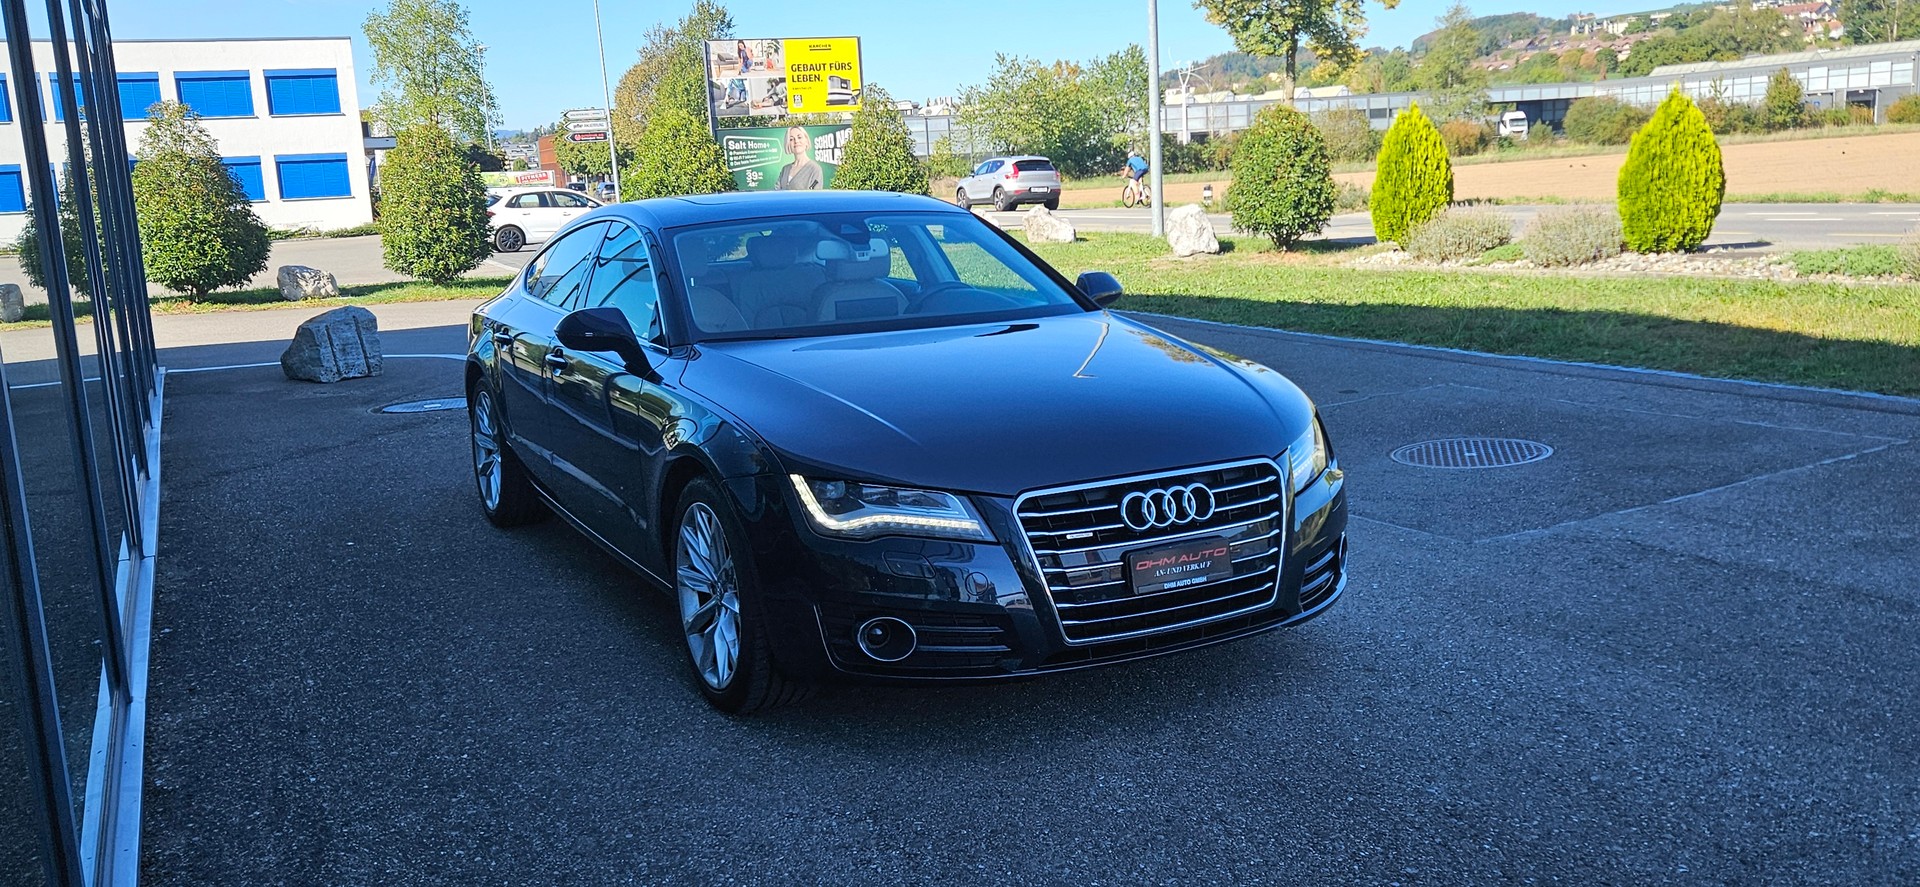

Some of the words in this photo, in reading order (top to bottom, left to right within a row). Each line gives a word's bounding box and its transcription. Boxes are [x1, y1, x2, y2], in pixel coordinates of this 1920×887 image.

[791, 63, 827, 72] GEBAUT
[829, 61, 852, 71] FÜRS
[791, 74, 823, 83] LEBEN.
[728, 140, 746, 150] Salt
[814, 132, 835, 149] SCHO
[746, 171, 758, 180] 39
[1178, 547, 1227, 563] AUTO
[1183, 561, 1212, 572] VERKAUF
[1177, 579, 1191, 587] AUTO
